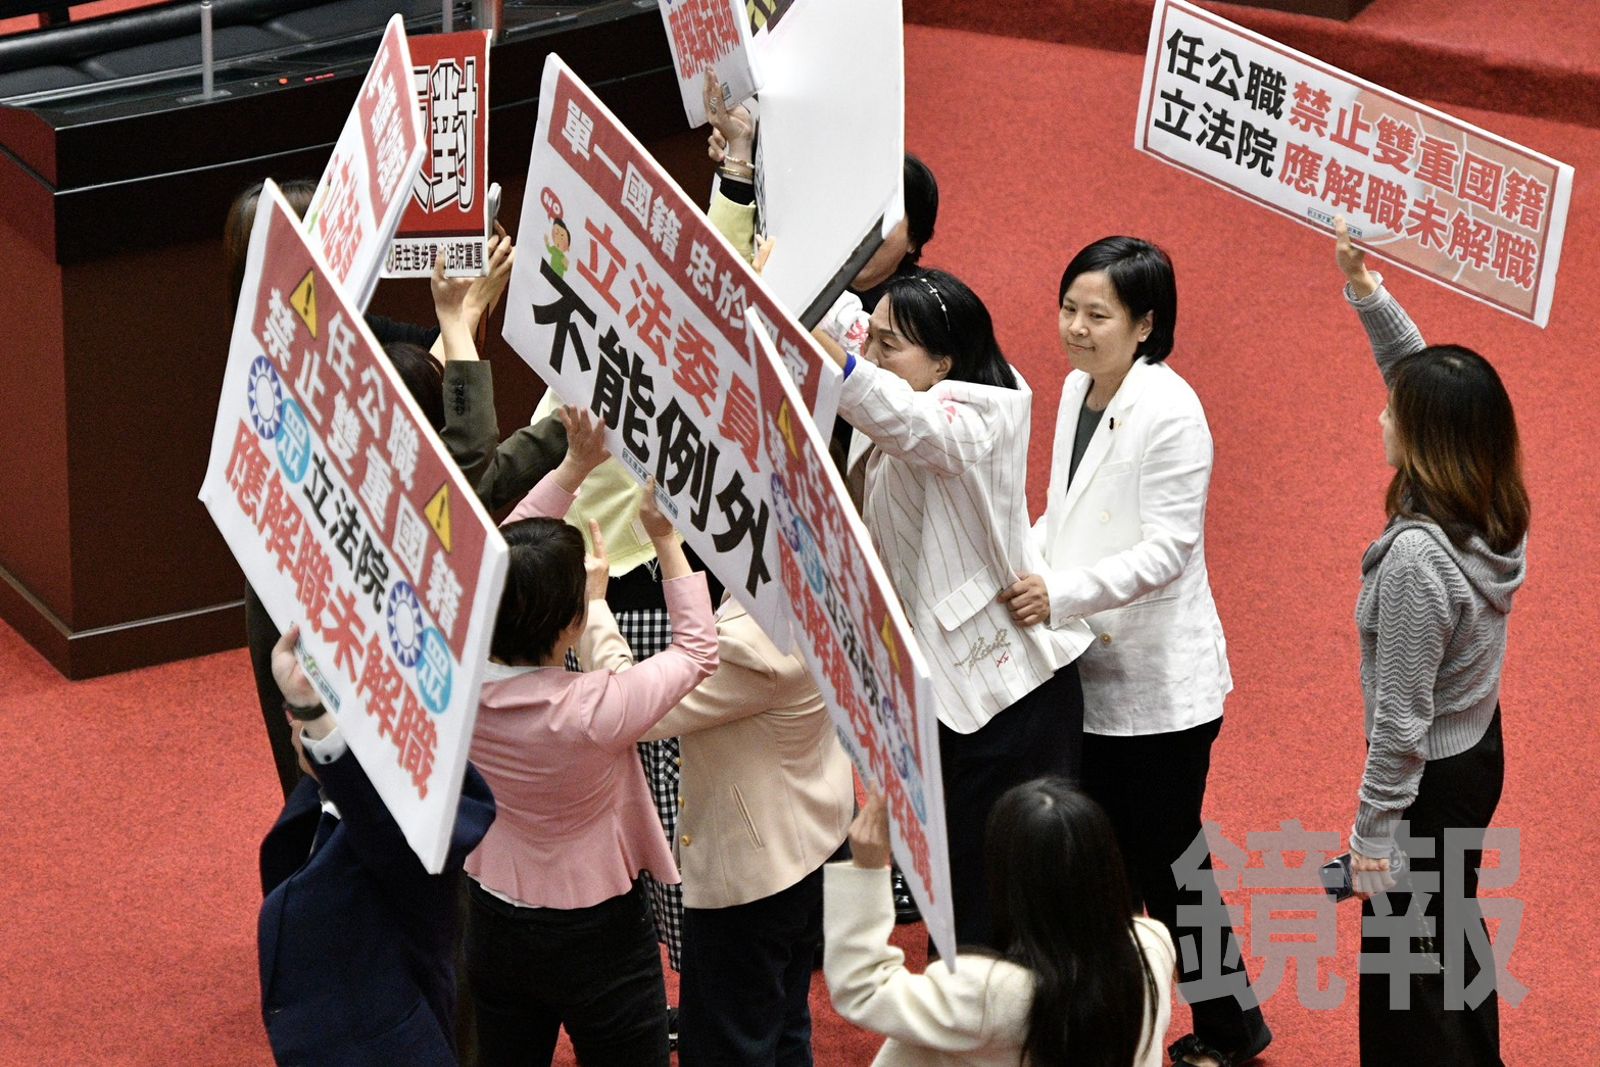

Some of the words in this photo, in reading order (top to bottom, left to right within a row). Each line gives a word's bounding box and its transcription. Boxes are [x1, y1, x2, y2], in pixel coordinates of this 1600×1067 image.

[395, 242, 482, 271] 民主進步黨法院黨團
[561, 98, 683, 263] 單一國籍
[326, 311, 420, 491] 任公職
[532, 257, 772, 599] 不能例外
[576, 217, 760, 473] 立法委員
[263, 287, 463, 640] 禁止雙重國籍
[302, 452, 389, 614] 立法院
[224, 418, 438, 800] 應解職未解職
